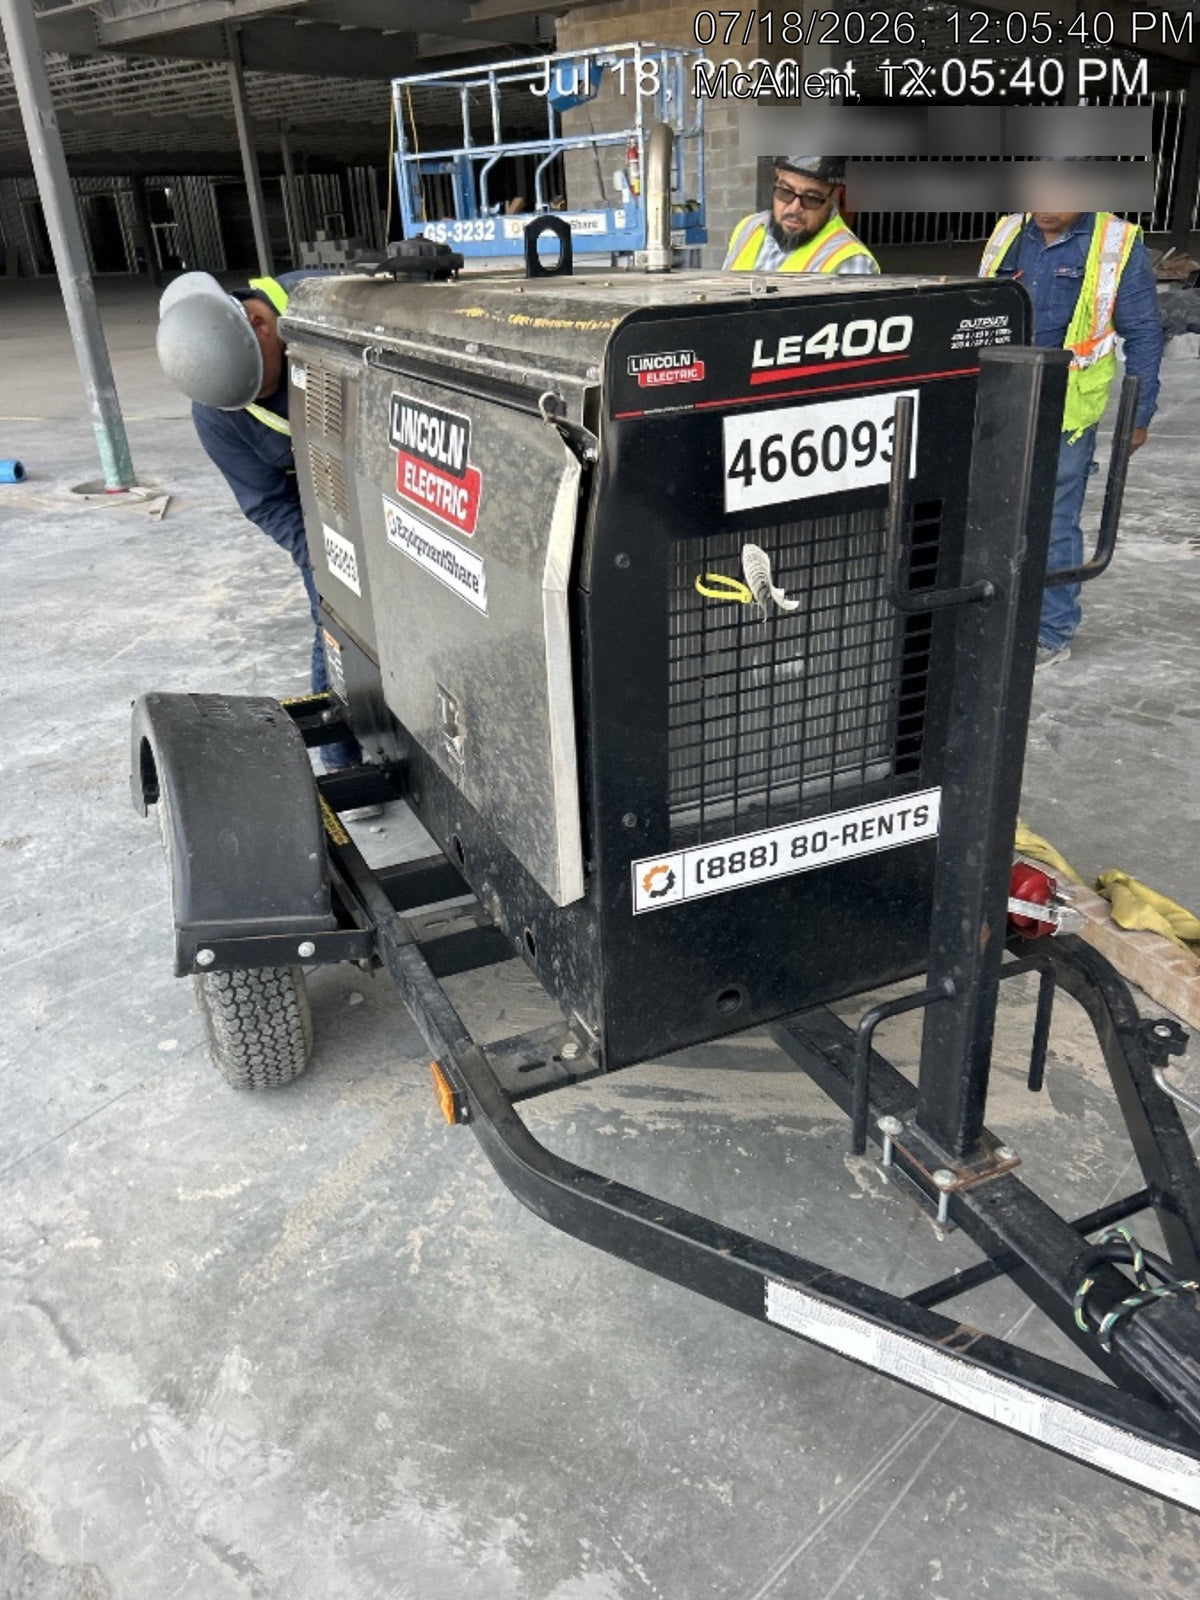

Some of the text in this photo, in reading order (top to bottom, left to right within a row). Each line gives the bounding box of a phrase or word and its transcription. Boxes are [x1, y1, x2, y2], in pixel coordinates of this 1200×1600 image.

[423, 219, 496, 244] GS-3232
[631, 353, 691, 372] LINCOLN
[752, 315, 914, 369] LE400
[646, 368, 698, 383] ELECTRIC
[392, 402, 466, 471] LINCOLN
[403, 461, 469, 521] ELECTRIC
[695, 804, 930, 885] (888) 80-RENTS
